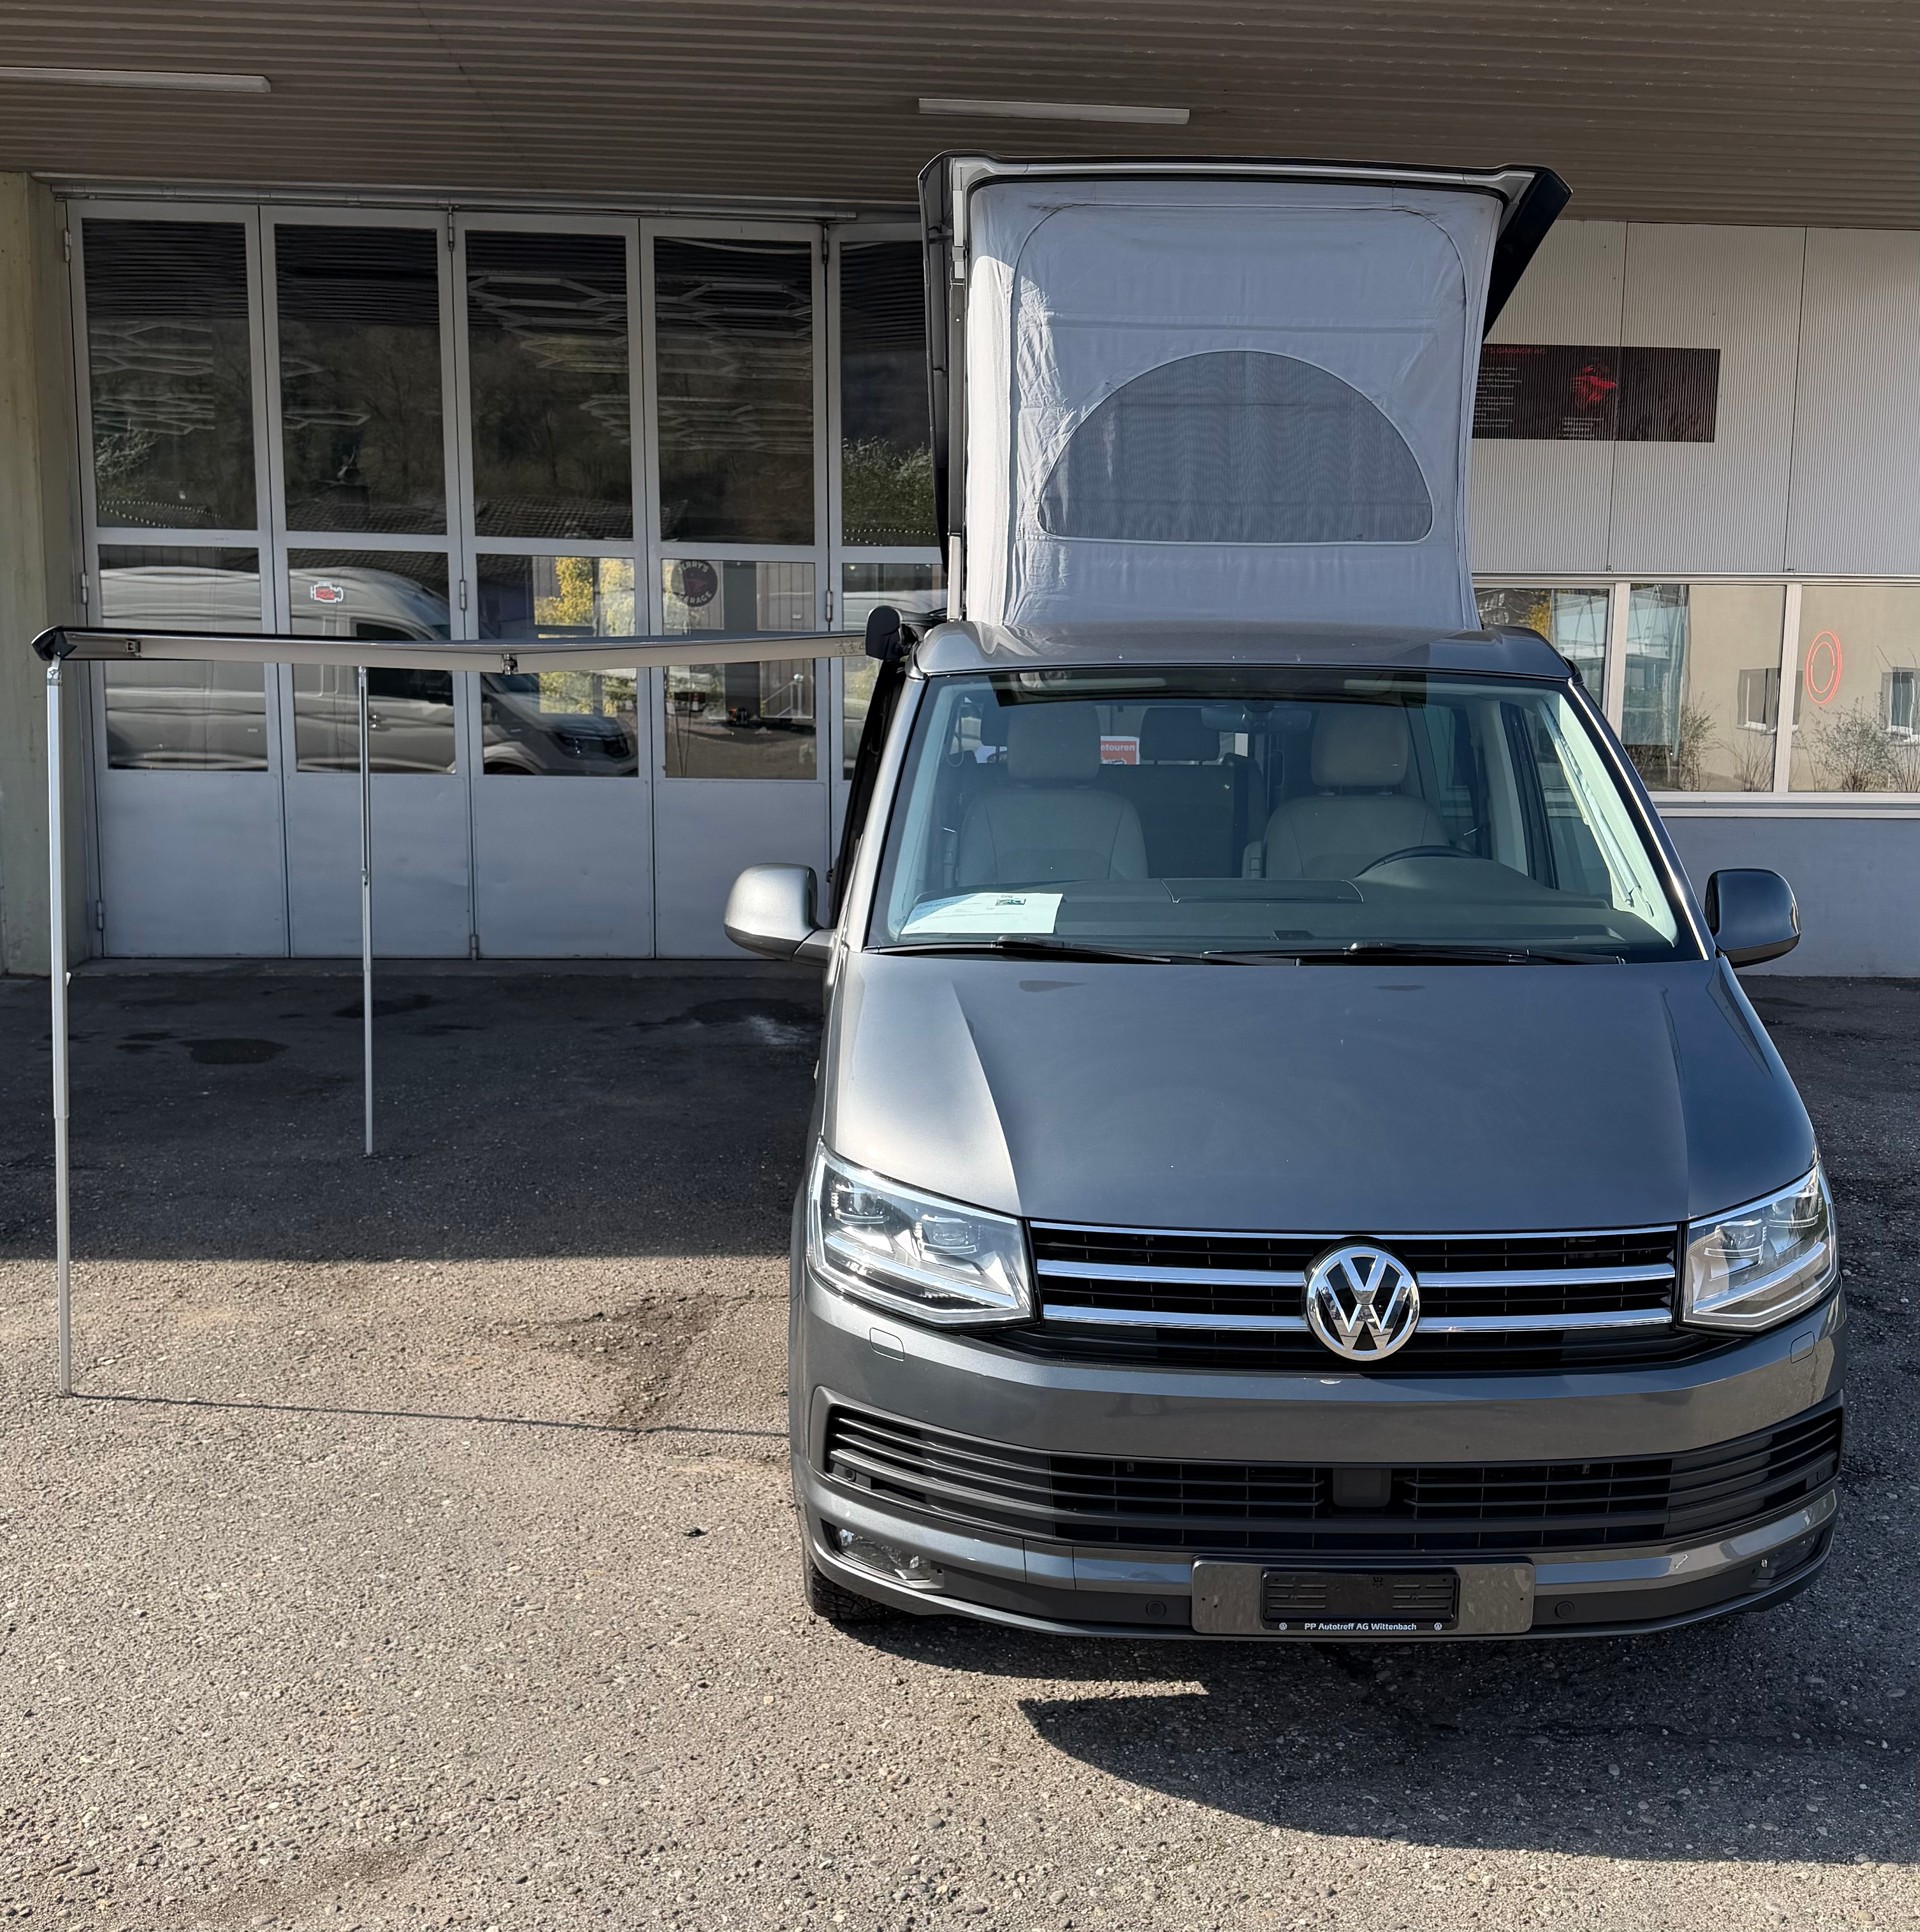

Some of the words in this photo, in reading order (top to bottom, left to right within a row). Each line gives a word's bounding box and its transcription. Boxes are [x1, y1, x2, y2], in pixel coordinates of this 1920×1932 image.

[1304, 1622, 1317, 1631] PP
[1318, 1622, 1355, 1631] Autotreff
[1356, 1622, 1369, 1631] AG
[1370, 1622, 1417, 1631] Wittenbach
